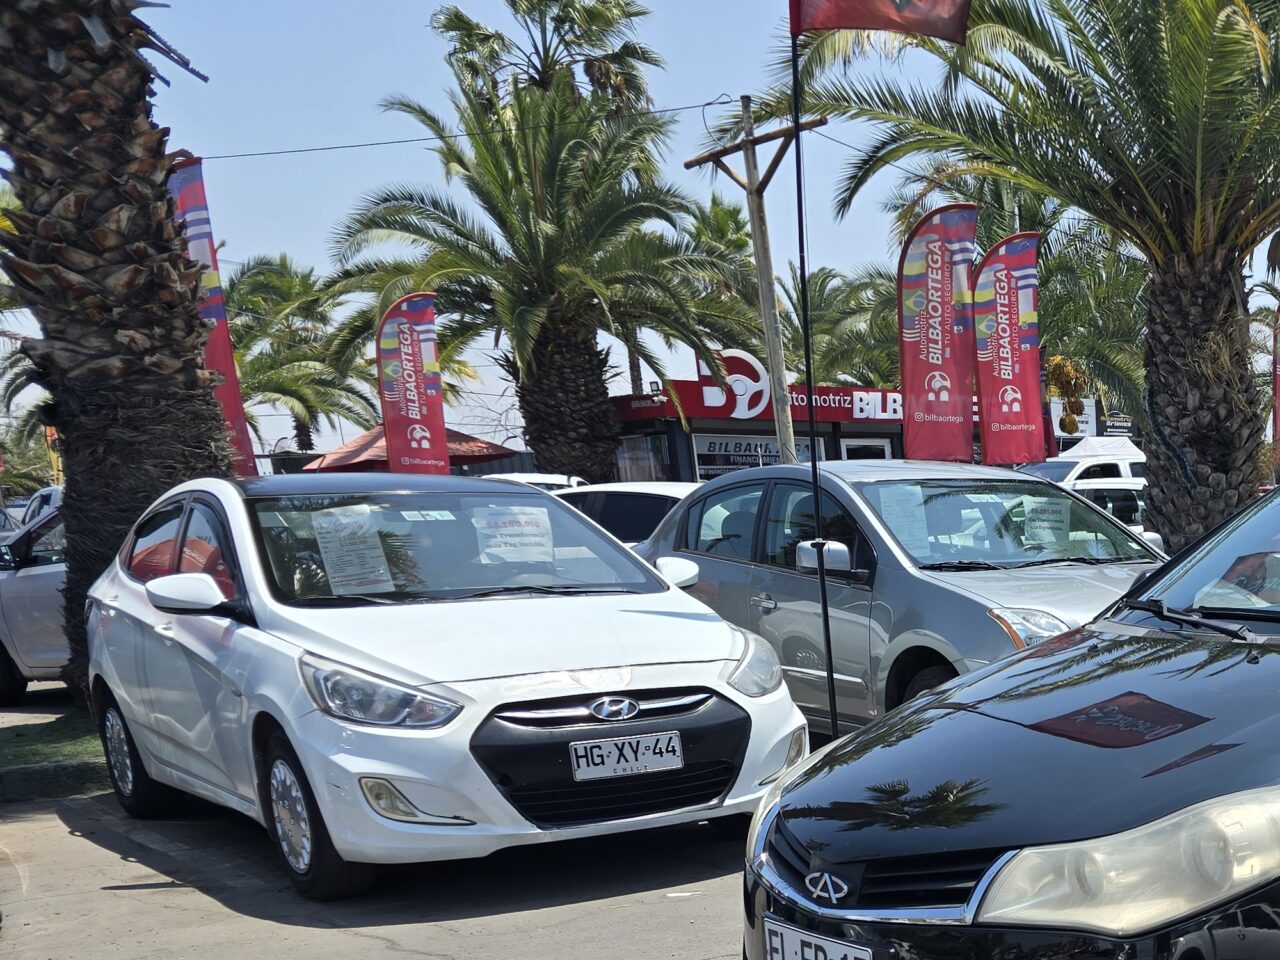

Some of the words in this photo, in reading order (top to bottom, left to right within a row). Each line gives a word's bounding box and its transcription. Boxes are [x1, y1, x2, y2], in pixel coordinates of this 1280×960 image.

[927, 240, 943, 365] BILBAORTEGA
[996, 268, 1013, 380] BILBAORTEGA
[1011, 289, 1019, 323] SEGURO
[919, 309, 927, 361] Automotriz
[991, 331, 999, 377] Automotriz
[399, 322, 421, 420] BILBAORTEGA
[924, 414, 964, 424] bilbaortega
[1000, 422, 1036, 432] bilbaortega
[613, 765, 649, 774] CHILE
